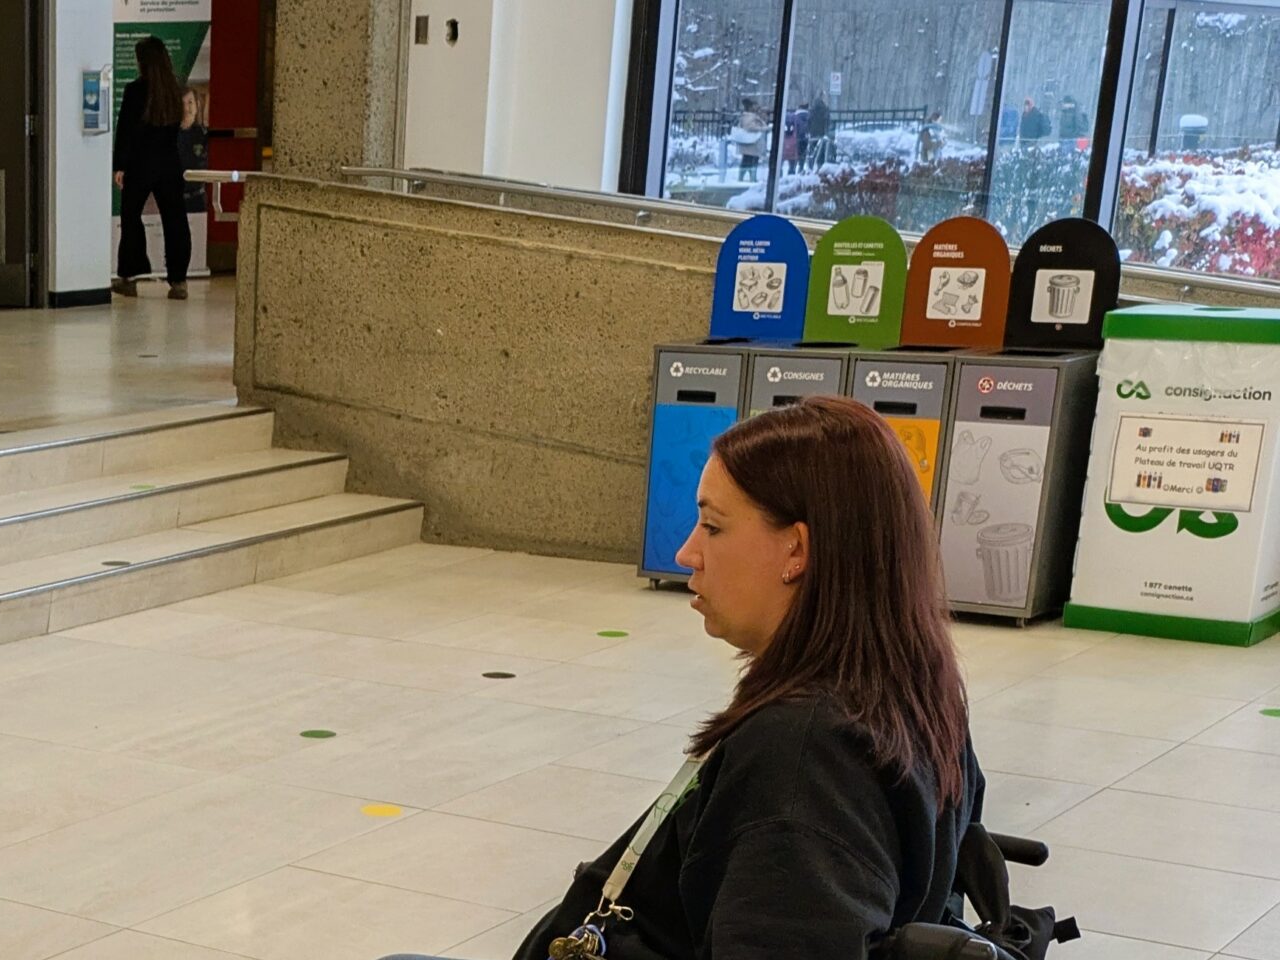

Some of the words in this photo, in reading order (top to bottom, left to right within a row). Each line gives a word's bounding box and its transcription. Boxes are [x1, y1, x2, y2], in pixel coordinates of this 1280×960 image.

[1039, 244, 1063, 253] DÉCHETS
[684, 366, 728, 376] RECYCLABLE
[782, 371, 825, 381] CONSIGNES
[882, 372, 920, 381] MATIÈRES
[881, 379, 933, 390] ORGANIQUES
[996, 381, 1033, 391] DÉCHETS
[1136, 444, 1147, 452] Au
[1149, 445, 1173, 454] profit
[1176, 445, 1190, 455] des
[1192, 448, 1225, 458] usagers
[1227, 448, 1238, 458] du
[1134, 457, 1164, 467] Plateau
[1166, 459, 1176, 467] de
[1178, 460, 1206, 469] travail
[1208, 462, 1235, 472] UQTR
[1170, 485, 1194, 494] Merci
